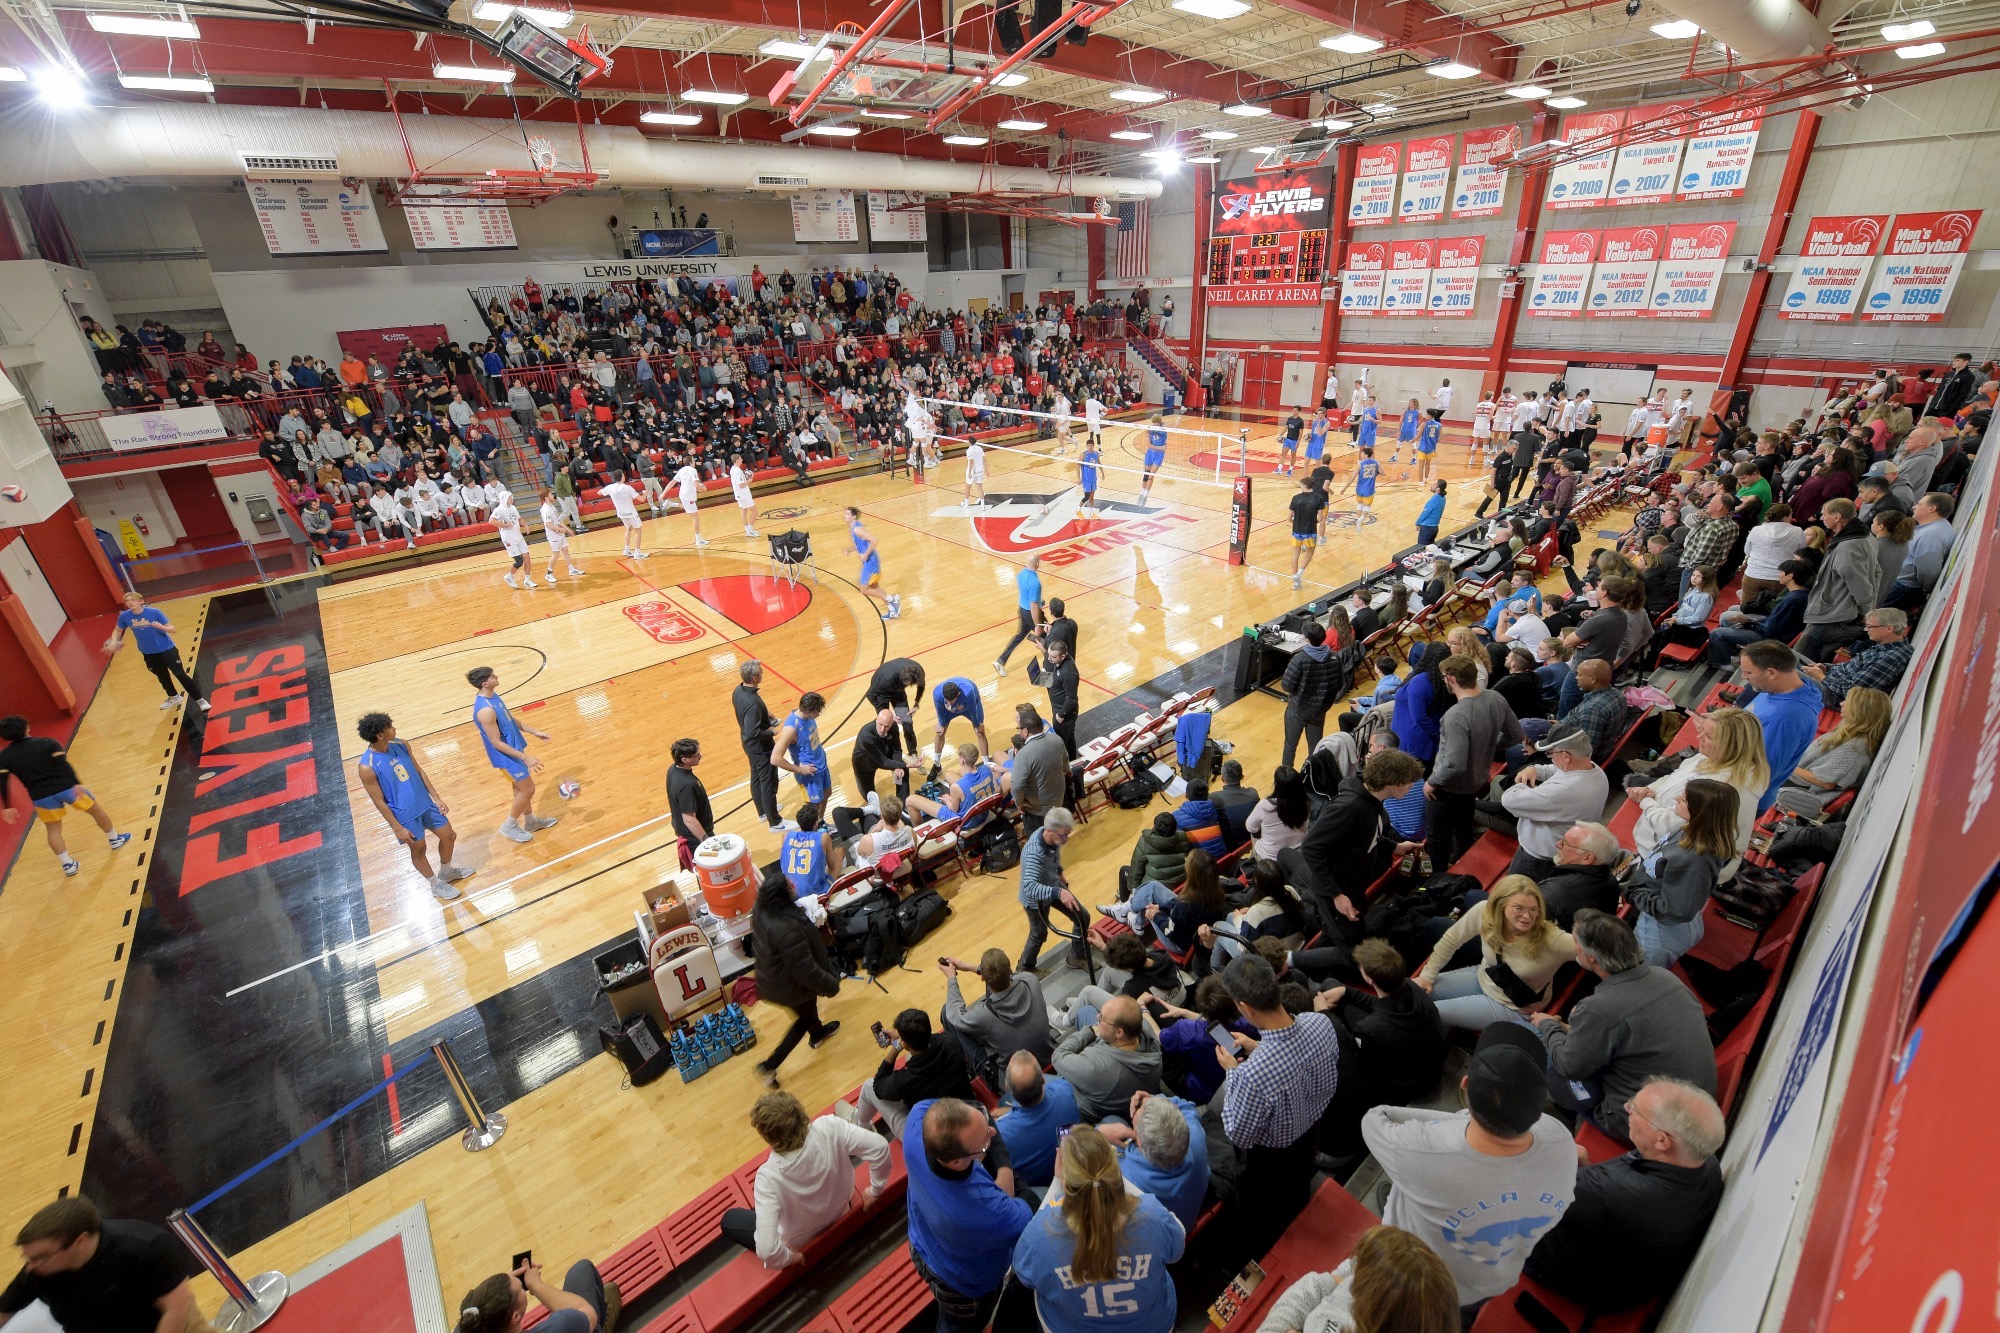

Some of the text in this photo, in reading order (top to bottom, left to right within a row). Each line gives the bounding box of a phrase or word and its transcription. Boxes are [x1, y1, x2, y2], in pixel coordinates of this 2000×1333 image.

[1693, 141, 1713, 150] NCAA
[1715, 138, 1744, 148] Division
[1411, 149, 1438, 160] Women's
[1624, 148, 1641, 158] NCAA
[1644, 147, 1670, 156] Division
[1717, 147, 1749, 157] National
[1361, 156, 1386, 166] Women's
[1410, 156, 1446, 170] Volleyball
[1642, 157, 1664, 166] Sweet
[1360, 163, 1393, 176] Volleyball
[1635, 175, 1670, 191] 2007
[1710, 169, 1742, 186] 1981
[1572, 180, 1603, 195] 2009
[1255, 187, 1311, 203] LEWIS
[1473, 190, 1499, 205] 2016
[1703, 190, 1733, 199] University
[1250, 198, 1324, 217] FLYERS
[1367, 201, 1388, 214] 2018
[1418, 196, 1441, 210] 2017
[1811, 231, 1843, 242] Men's
[1896, 228, 1931, 240] Men's
[1548, 243, 1569, 252] Men's
[1607, 241, 1630, 250] Men's
[1671, 237, 1697, 247] Men's
[1893, 238, 1962, 254] Volleyball
[1441, 249, 1459, 257] Men's
[1606, 248, 1653, 262] Volleyball
[1670, 245, 1722, 260] Volleyball
[1808, 242, 1870, 256] Volleyball
[1394, 258, 1427, 269] Volleyball
[1440, 256, 1476, 268] Volleyball
[1546, 251, 1589, 264] Volleyball
[584, 263, 717, 277] LEWIS UNIVERSITY
[1351, 260, 1382, 270] Volleyball
[1802, 267, 1861, 276] NCAA National
[1886, 265, 1952, 275] NCAA National
[1808, 277, 1857, 285] Semifinalist
[1893, 276, 1948, 285] Semifinalist
[1208, 289, 1317, 301] NEIL CAREY ARENA
[1356, 295, 1378, 306] 2021
[1447, 294, 1470, 305] 2015
[1552, 291, 1579, 303] 2014
[1614, 290, 1643, 303] 2012
[1673, 289, 1708, 303] 2004
[1816, 289, 1852, 304] 1998
[1902, 289, 1942, 304] 1996
[149, 433, 177, 441] Strong
[178, 427, 222, 437] Foundation
[1230, 504, 1239, 544] FLYERS
[1038, 513, 1199, 566] LEWIS
[179, 644, 322, 898] FLYERS
[882, 840, 908, 851] BRUINS
[788, 849, 812, 874] 13
[715, 866, 736, 877] LEWIS
[656, 932, 700, 959] LEWIS
[674, 964, 706, 1001] L
[1444, 1191, 1519, 1230] UCLA
[1054, 1254, 1152, 1289] HSH
[1081, 1282, 1138, 1317] 15
